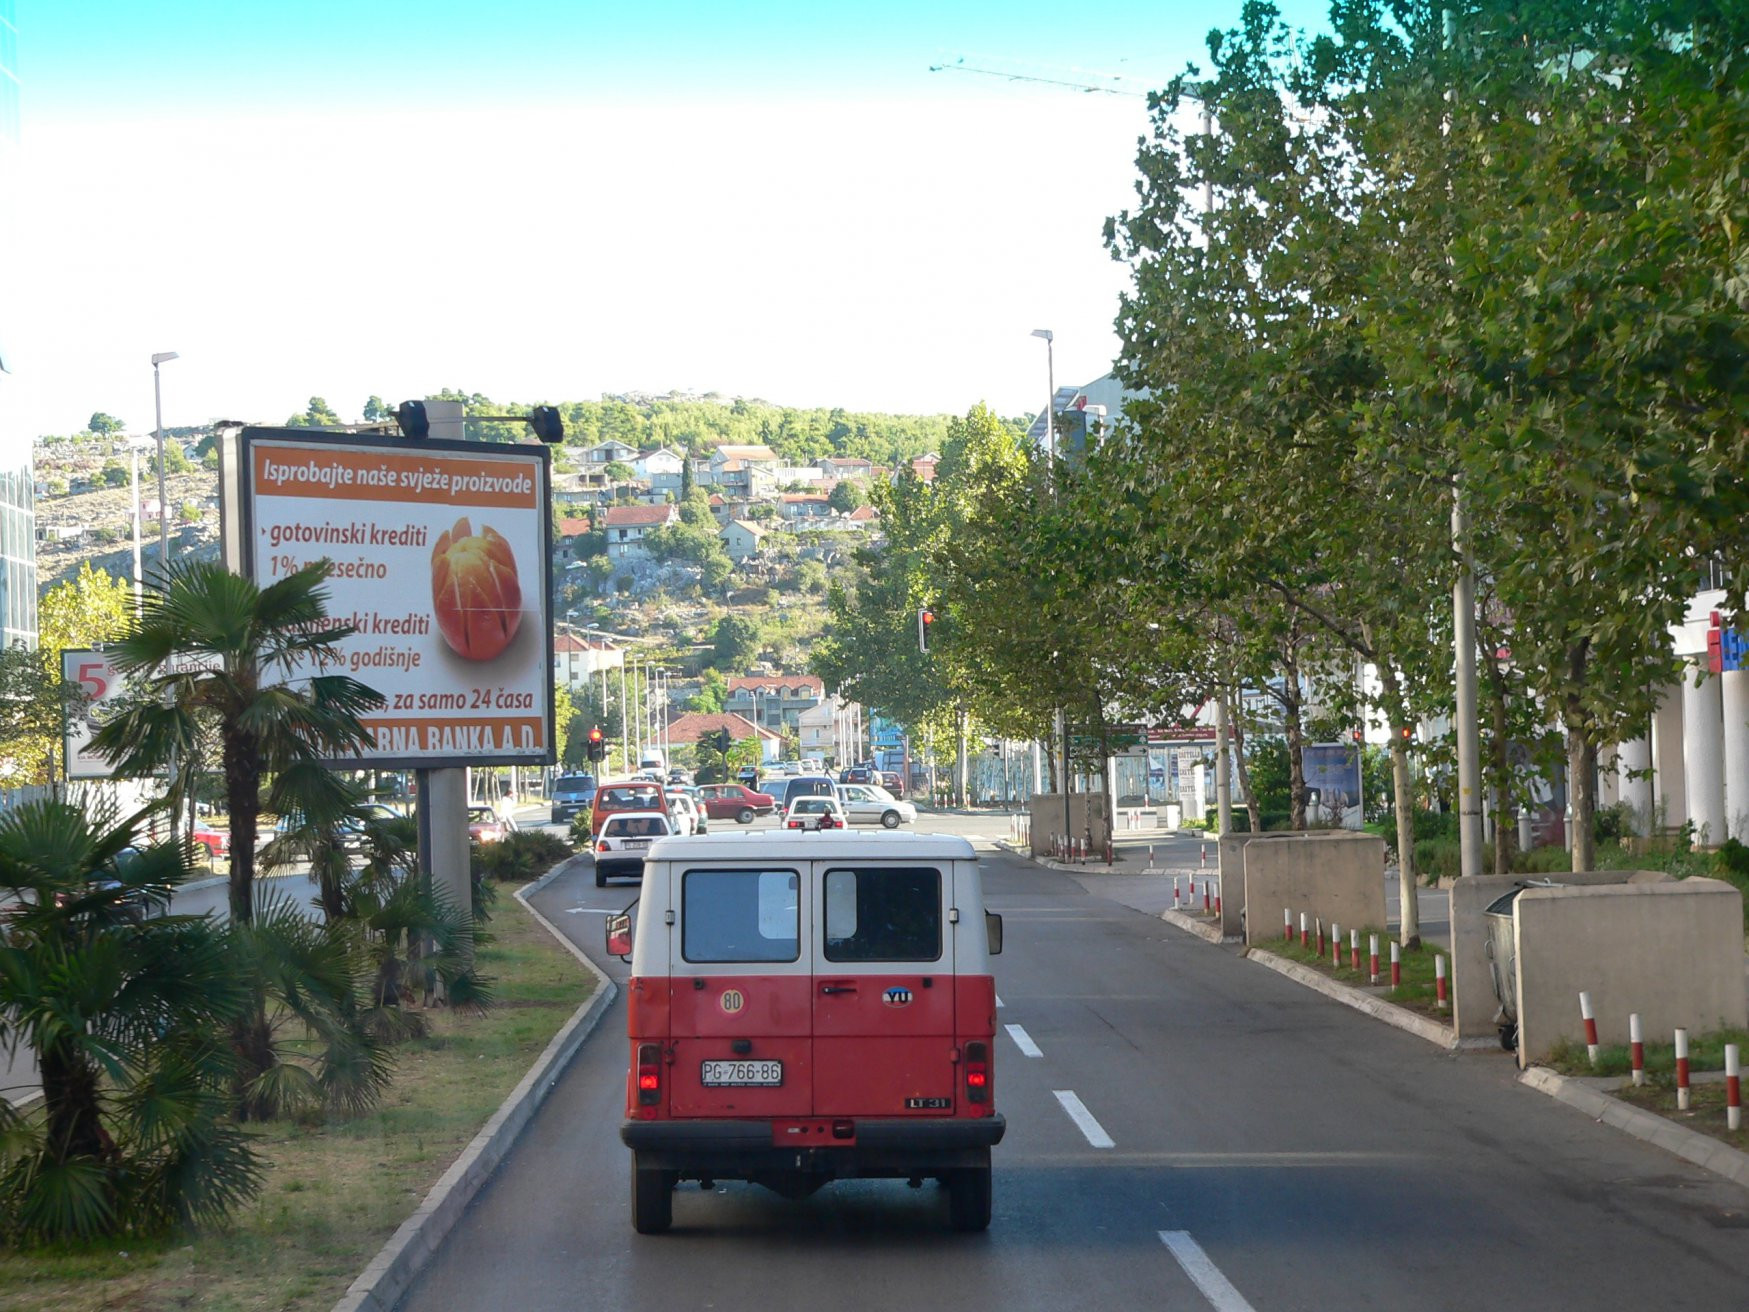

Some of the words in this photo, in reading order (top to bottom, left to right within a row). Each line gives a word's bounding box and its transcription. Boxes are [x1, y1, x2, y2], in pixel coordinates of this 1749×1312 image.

[264, 459, 353, 488] Isprobajte
[357, 464, 397, 486] naše
[400, 467, 449, 493] svježe
[451, 471, 532, 496] proizvode
[270, 521, 366, 547] gotovinski
[369, 523, 428, 546] krediti
[304, 556, 387, 579] esečno
[372, 612, 430, 635] krediti
[350, 646, 421, 672] godišnje
[78, 663, 107, 700] 5
[393, 693, 414, 710] za
[418, 691, 466, 710] samo
[470, 688, 491, 709] 24
[495, 687, 534, 709] časa
[427, 725, 495, 750] BANKA
[723, 992, 741, 1010] 80
[888, 991, 910, 1003] YU
